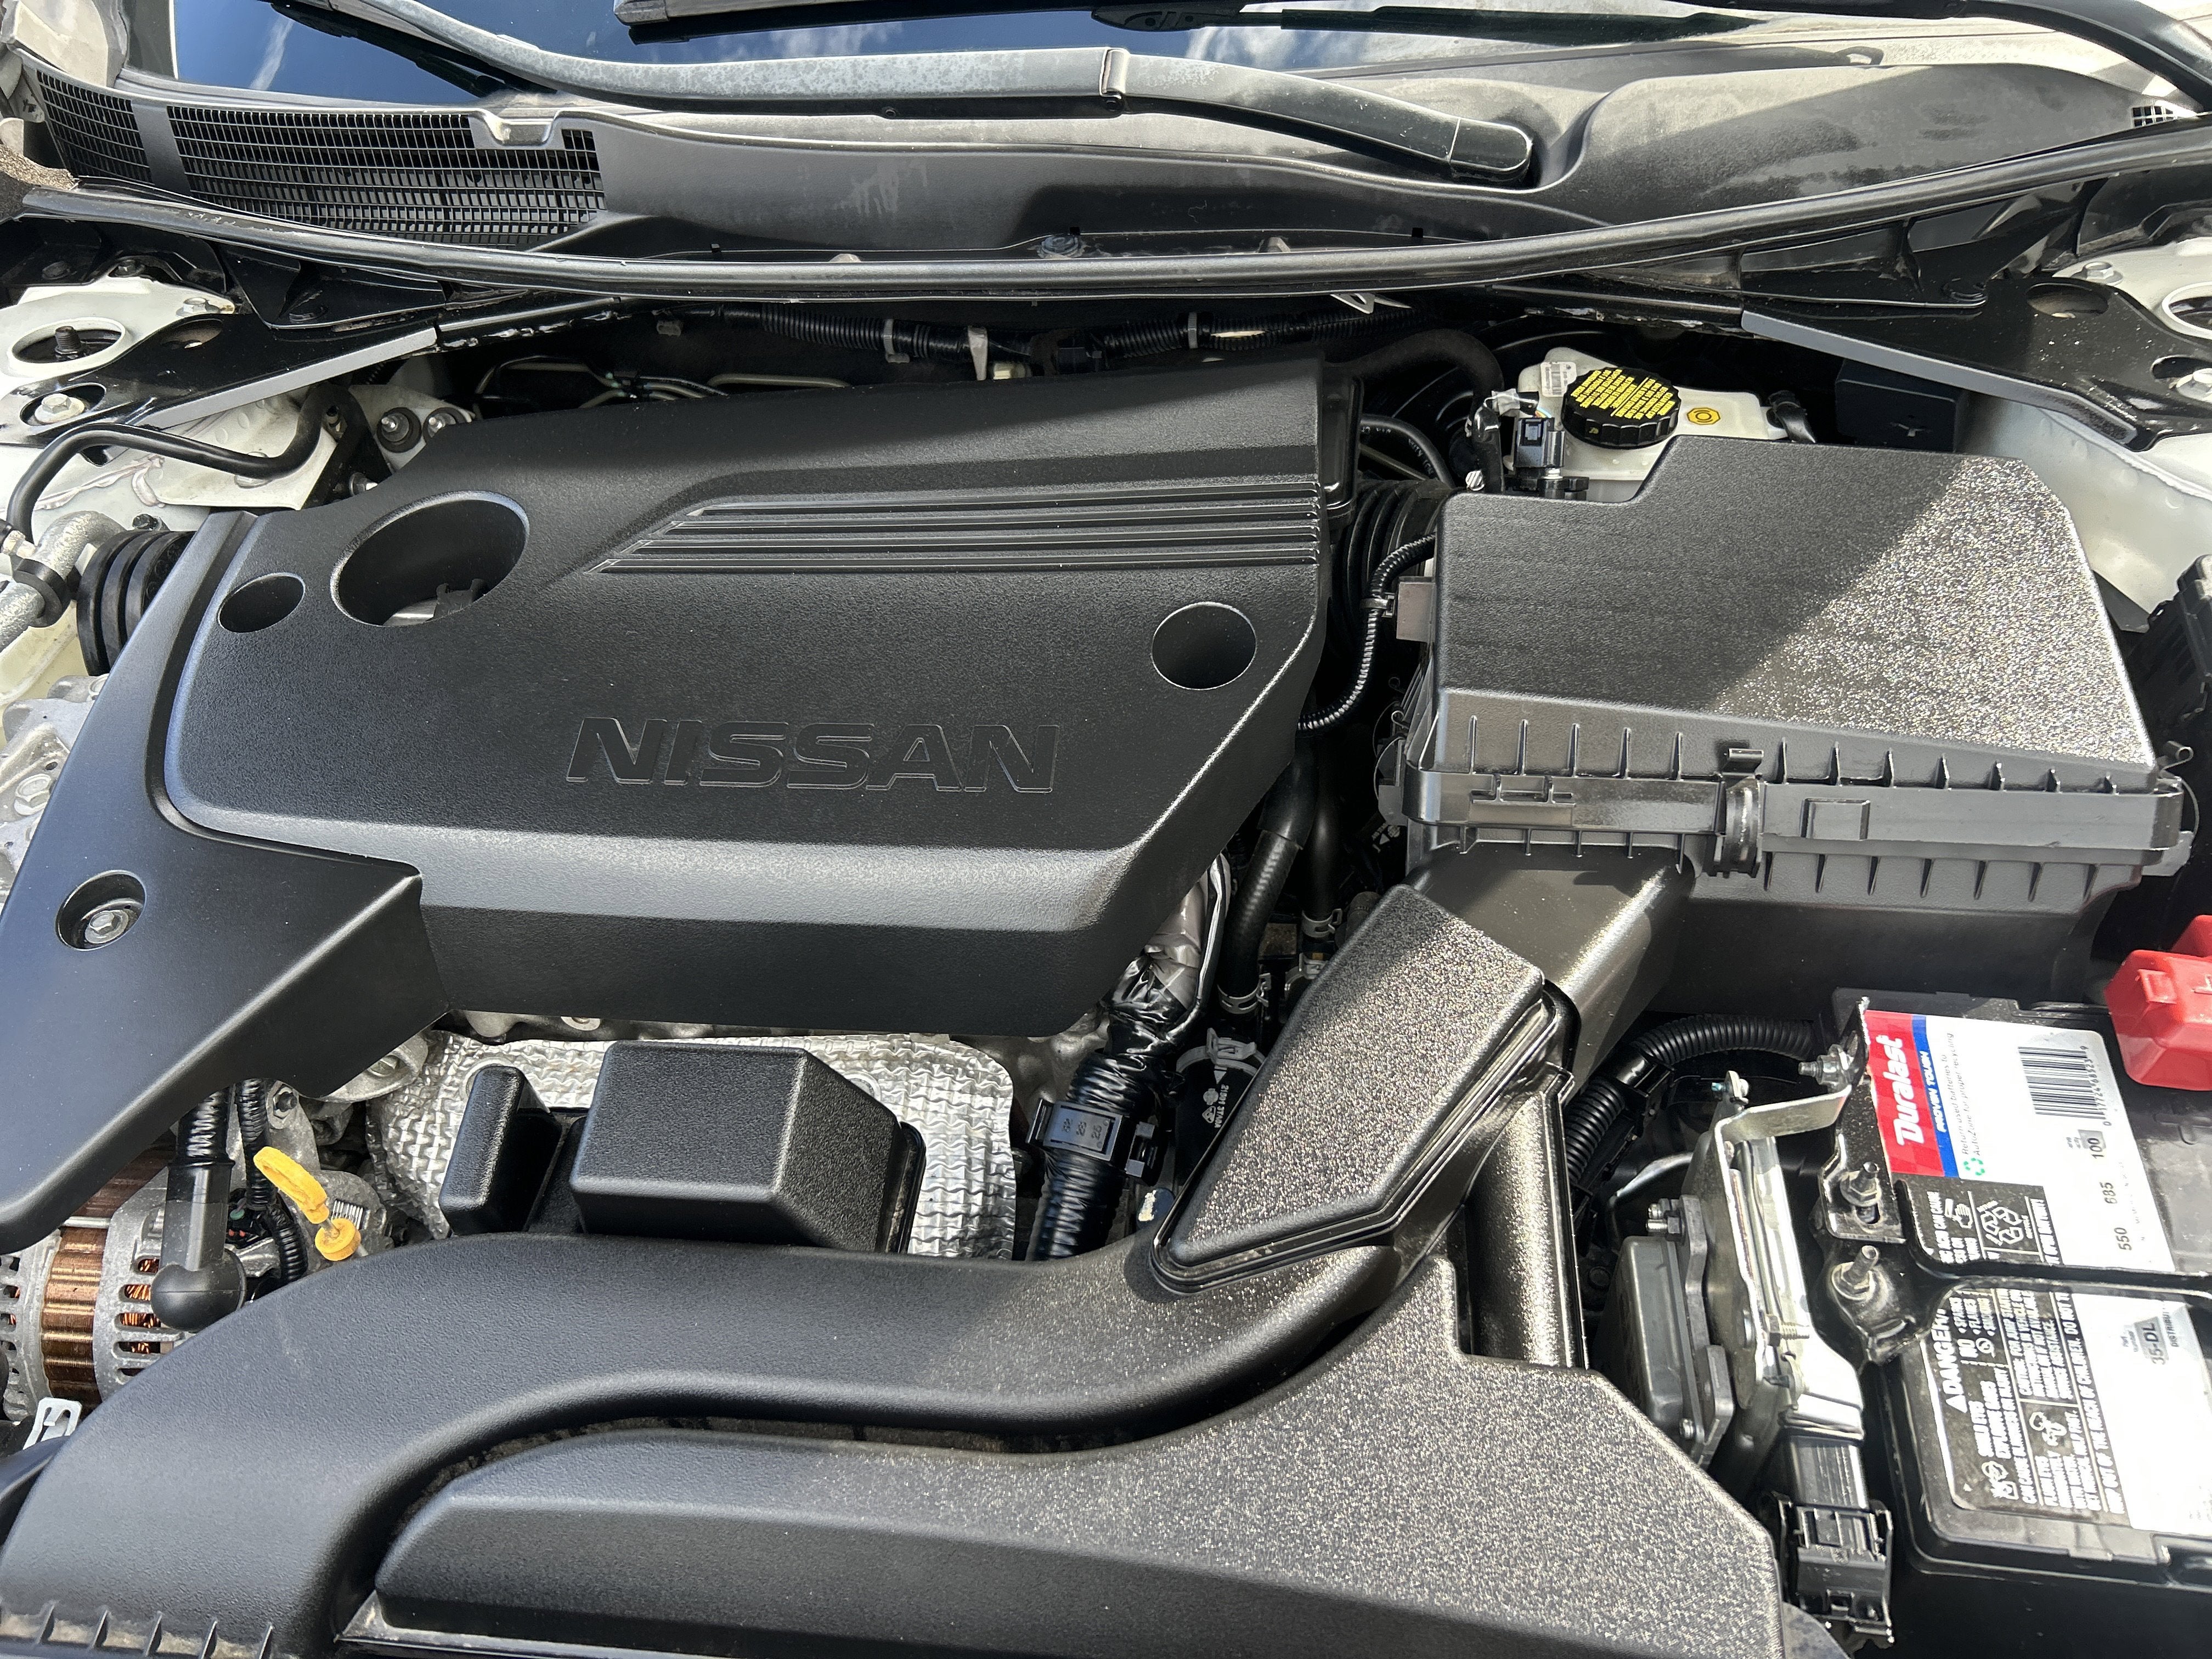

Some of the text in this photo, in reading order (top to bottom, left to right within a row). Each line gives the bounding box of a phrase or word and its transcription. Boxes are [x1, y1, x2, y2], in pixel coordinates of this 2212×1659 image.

[566, 716, 1060, 793] NISSAN
[1946, 1033, 1959, 1069] recycling
[1875, 1035, 1924, 1146] Duralast
[1920, 1051, 1946, 1132] PROVEN TOUGH
[1944, 1065, 1956, 1100] batteries
[1955, 1072, 1967, 1098] proper
[1951, 1103, 1962, 1122] used
[1959, 1126, 1969, 1154] Return
[1967, 1115, 1980, 1155] AutoZone
[2087, 1137, 2104, 1159] 100
[2100, 1182, 2117, 1204] 685
[2114, 1227, 2132, 1250] 550
[2142, 1323, 2165, 1365] 35-DL
